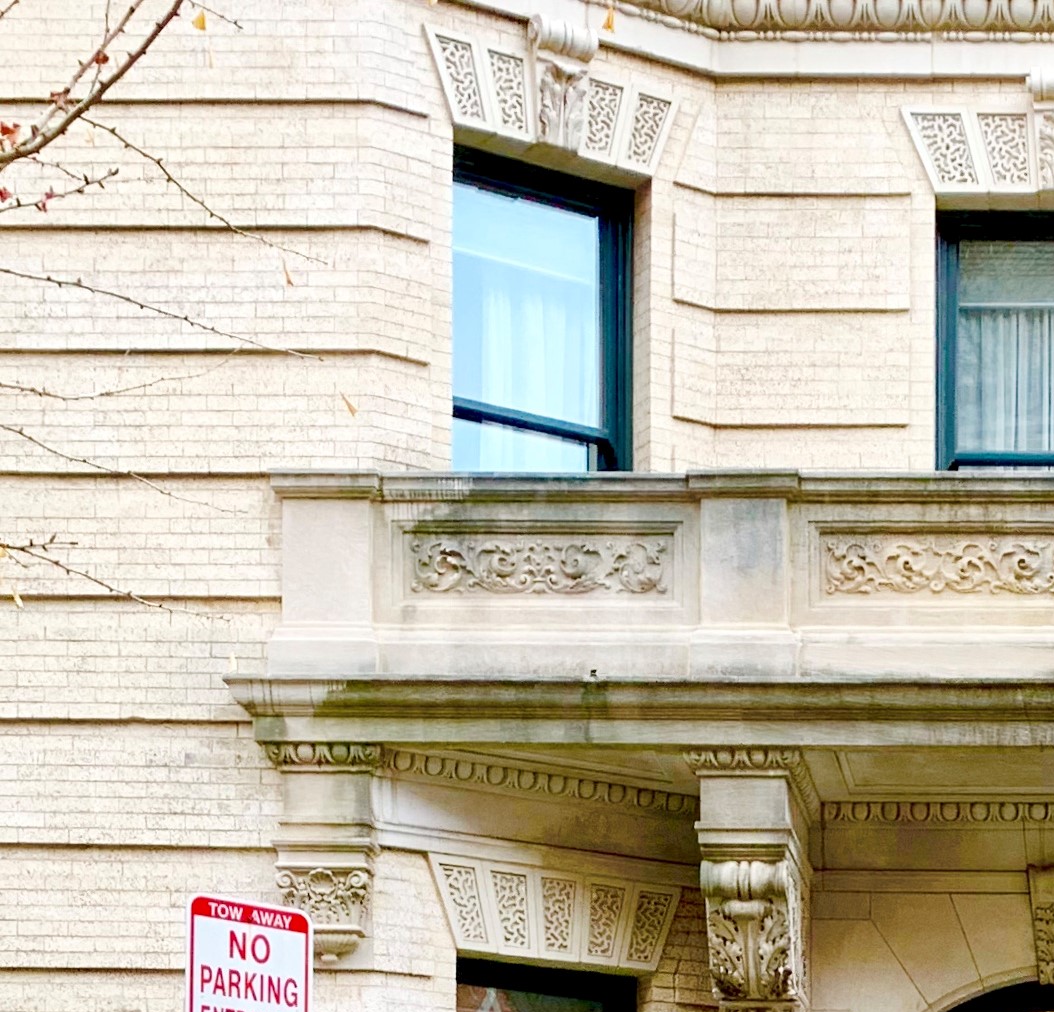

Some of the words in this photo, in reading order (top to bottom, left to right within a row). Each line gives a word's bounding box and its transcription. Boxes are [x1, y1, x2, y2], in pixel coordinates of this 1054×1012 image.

[208, 901, 243, 921] TOW
[251, 909, 293, 929] AWAY
[229, 930, 270, 964] NO
[200, 964, 298, 1008] PARKING
